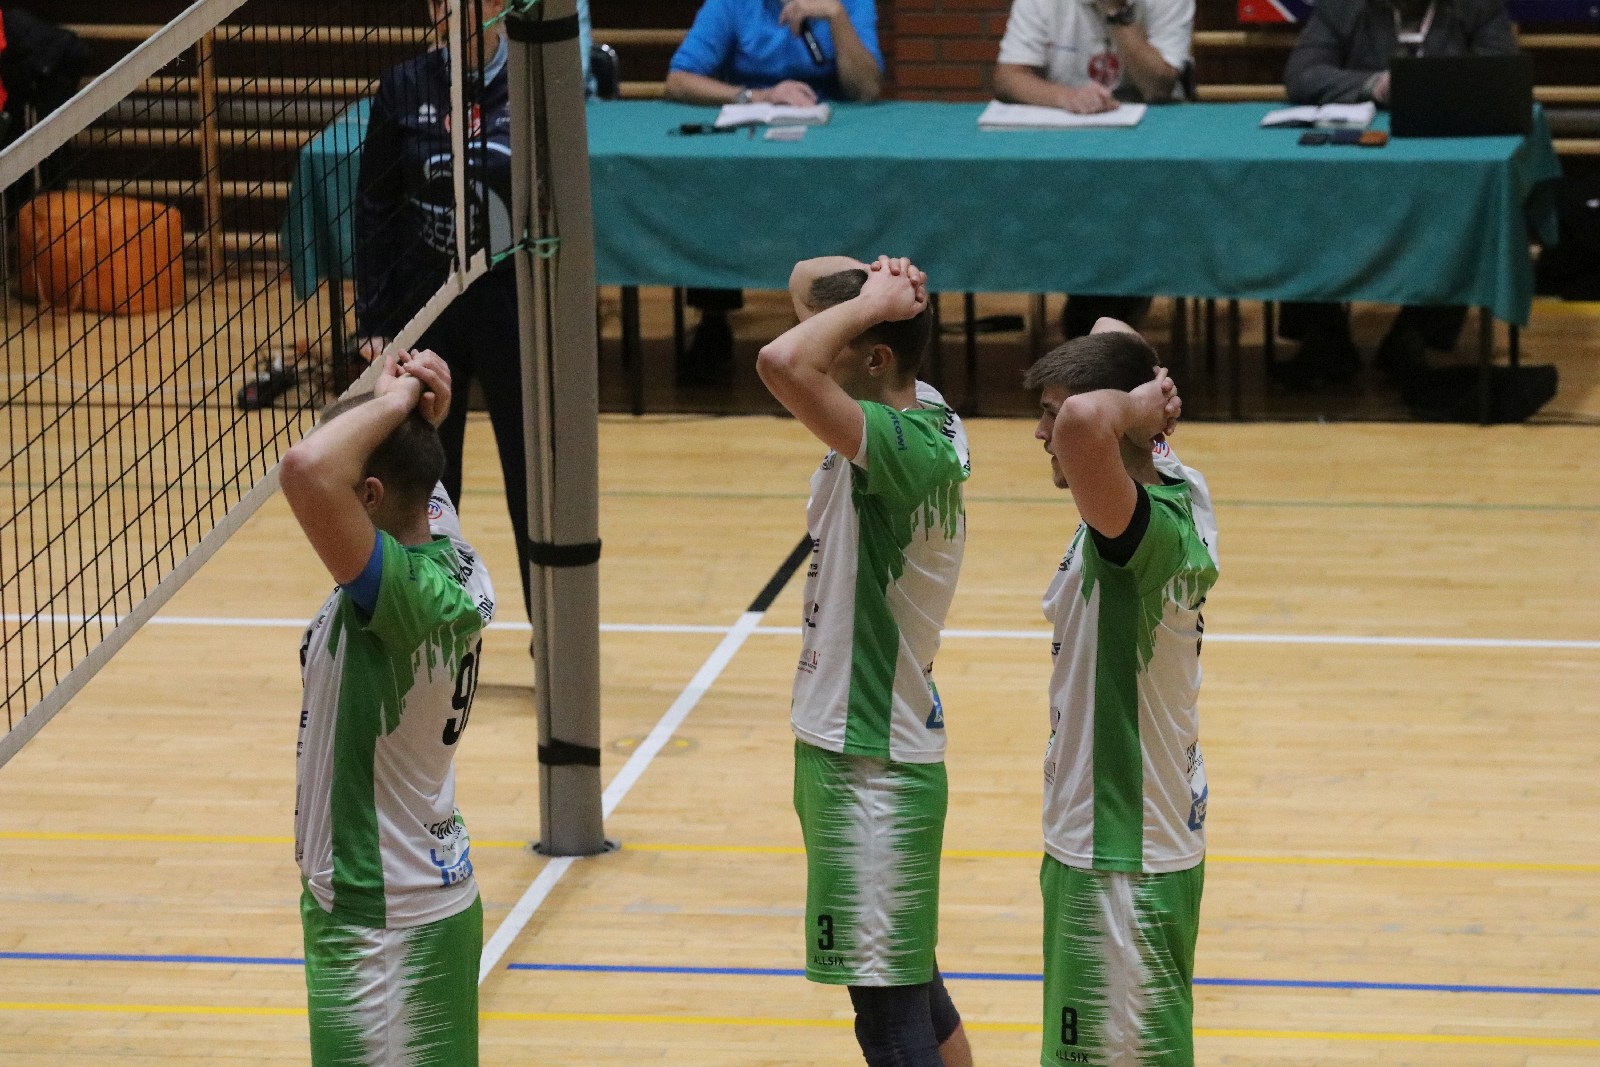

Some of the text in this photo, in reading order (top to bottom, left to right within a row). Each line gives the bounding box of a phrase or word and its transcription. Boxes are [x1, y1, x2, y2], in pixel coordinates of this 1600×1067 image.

[817, 914, 834, 951] 3
[813, 955, 845, 967] ALLSIX
[1061, 1006, 1078, 1046] 8
[1055, 1049, 1089, 1063] ALLSIX
